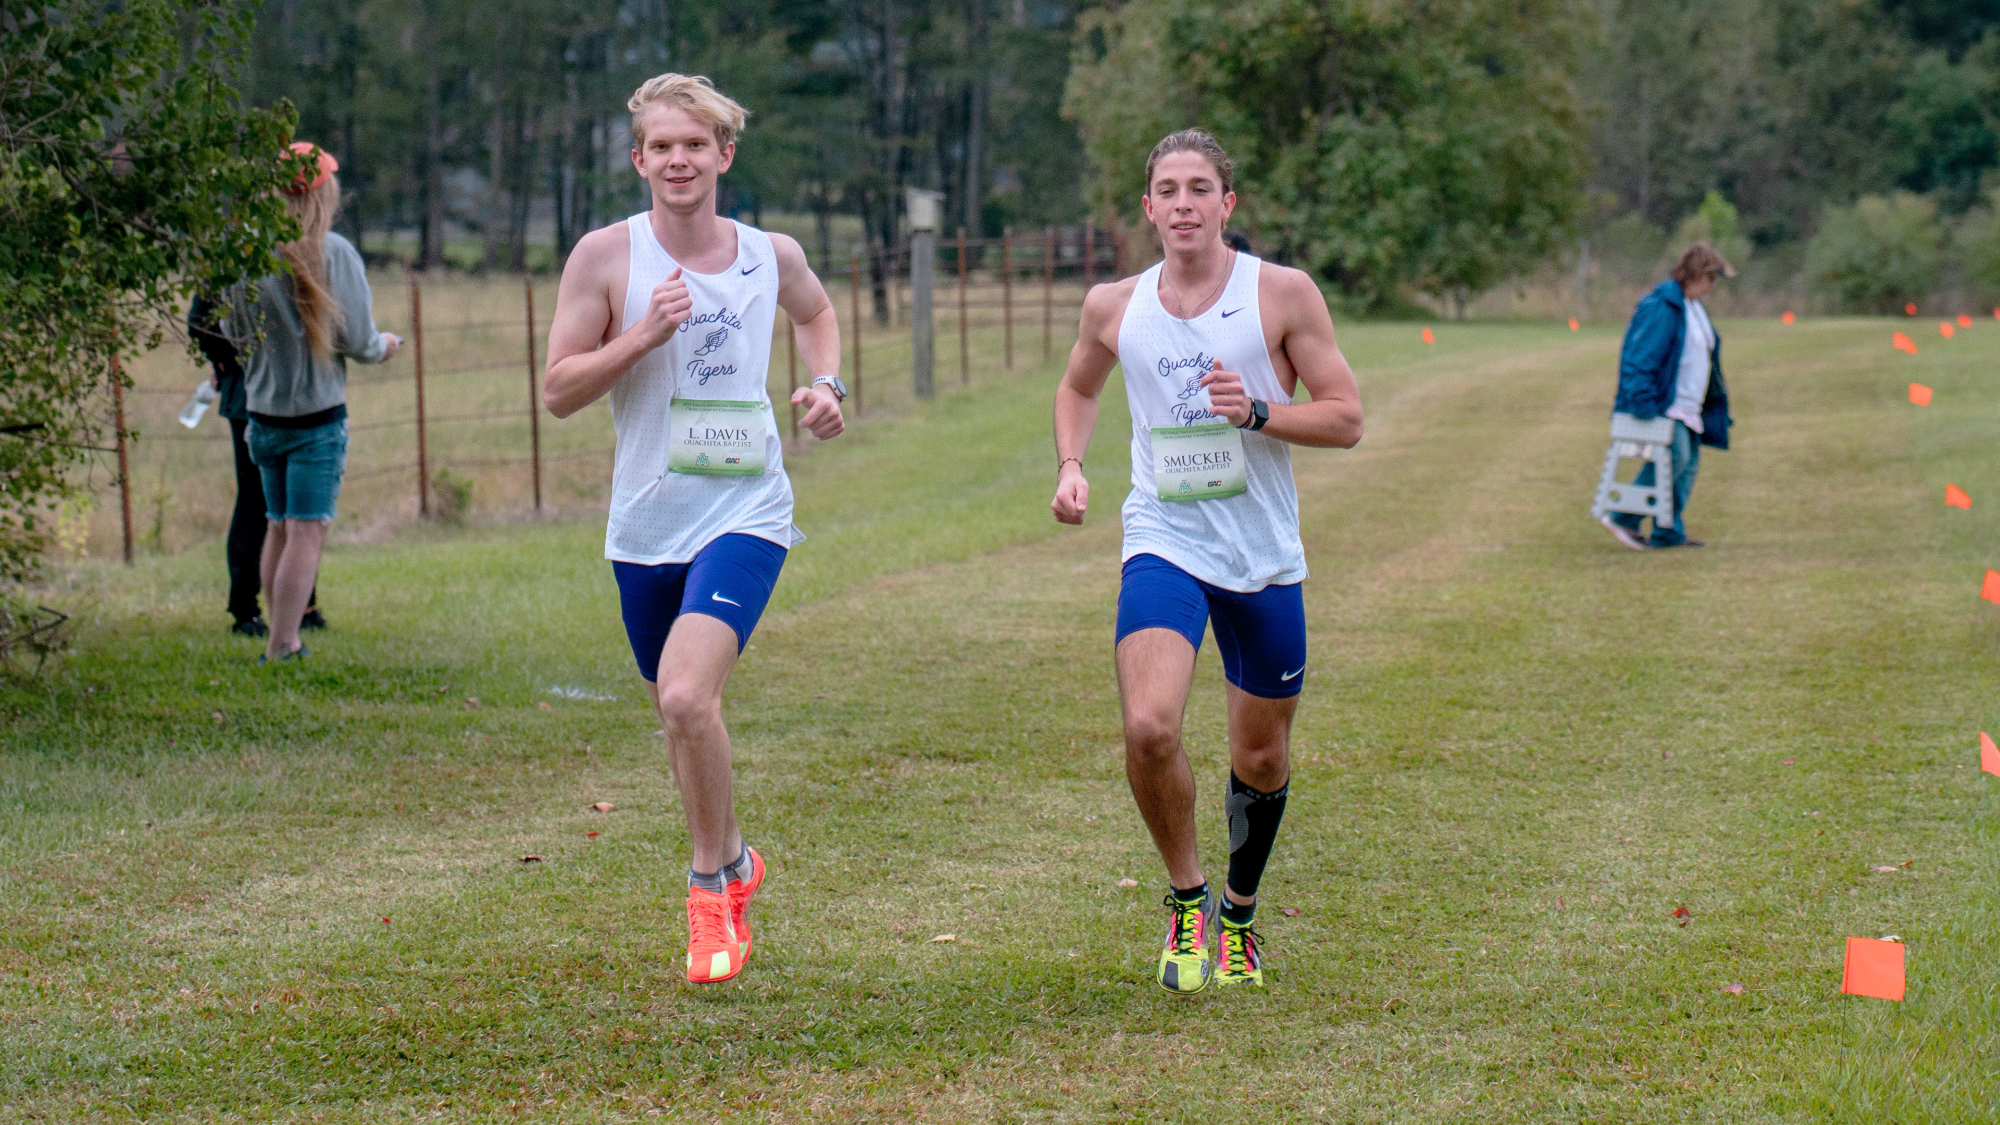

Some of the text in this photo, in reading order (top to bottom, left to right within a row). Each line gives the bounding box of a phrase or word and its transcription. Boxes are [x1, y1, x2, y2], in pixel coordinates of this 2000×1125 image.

[687, 359, 737, 386] Tigers
[689, 427, 748, 441] L. DAVIS
[683, 439, 721, 447] OUACHITA
[1163, 450, 1232, 468] SMUCKER
[1165, 462, 1231, 474] OUACHITA BAPTIST
[1207, 480, 1222, 488] GAC
